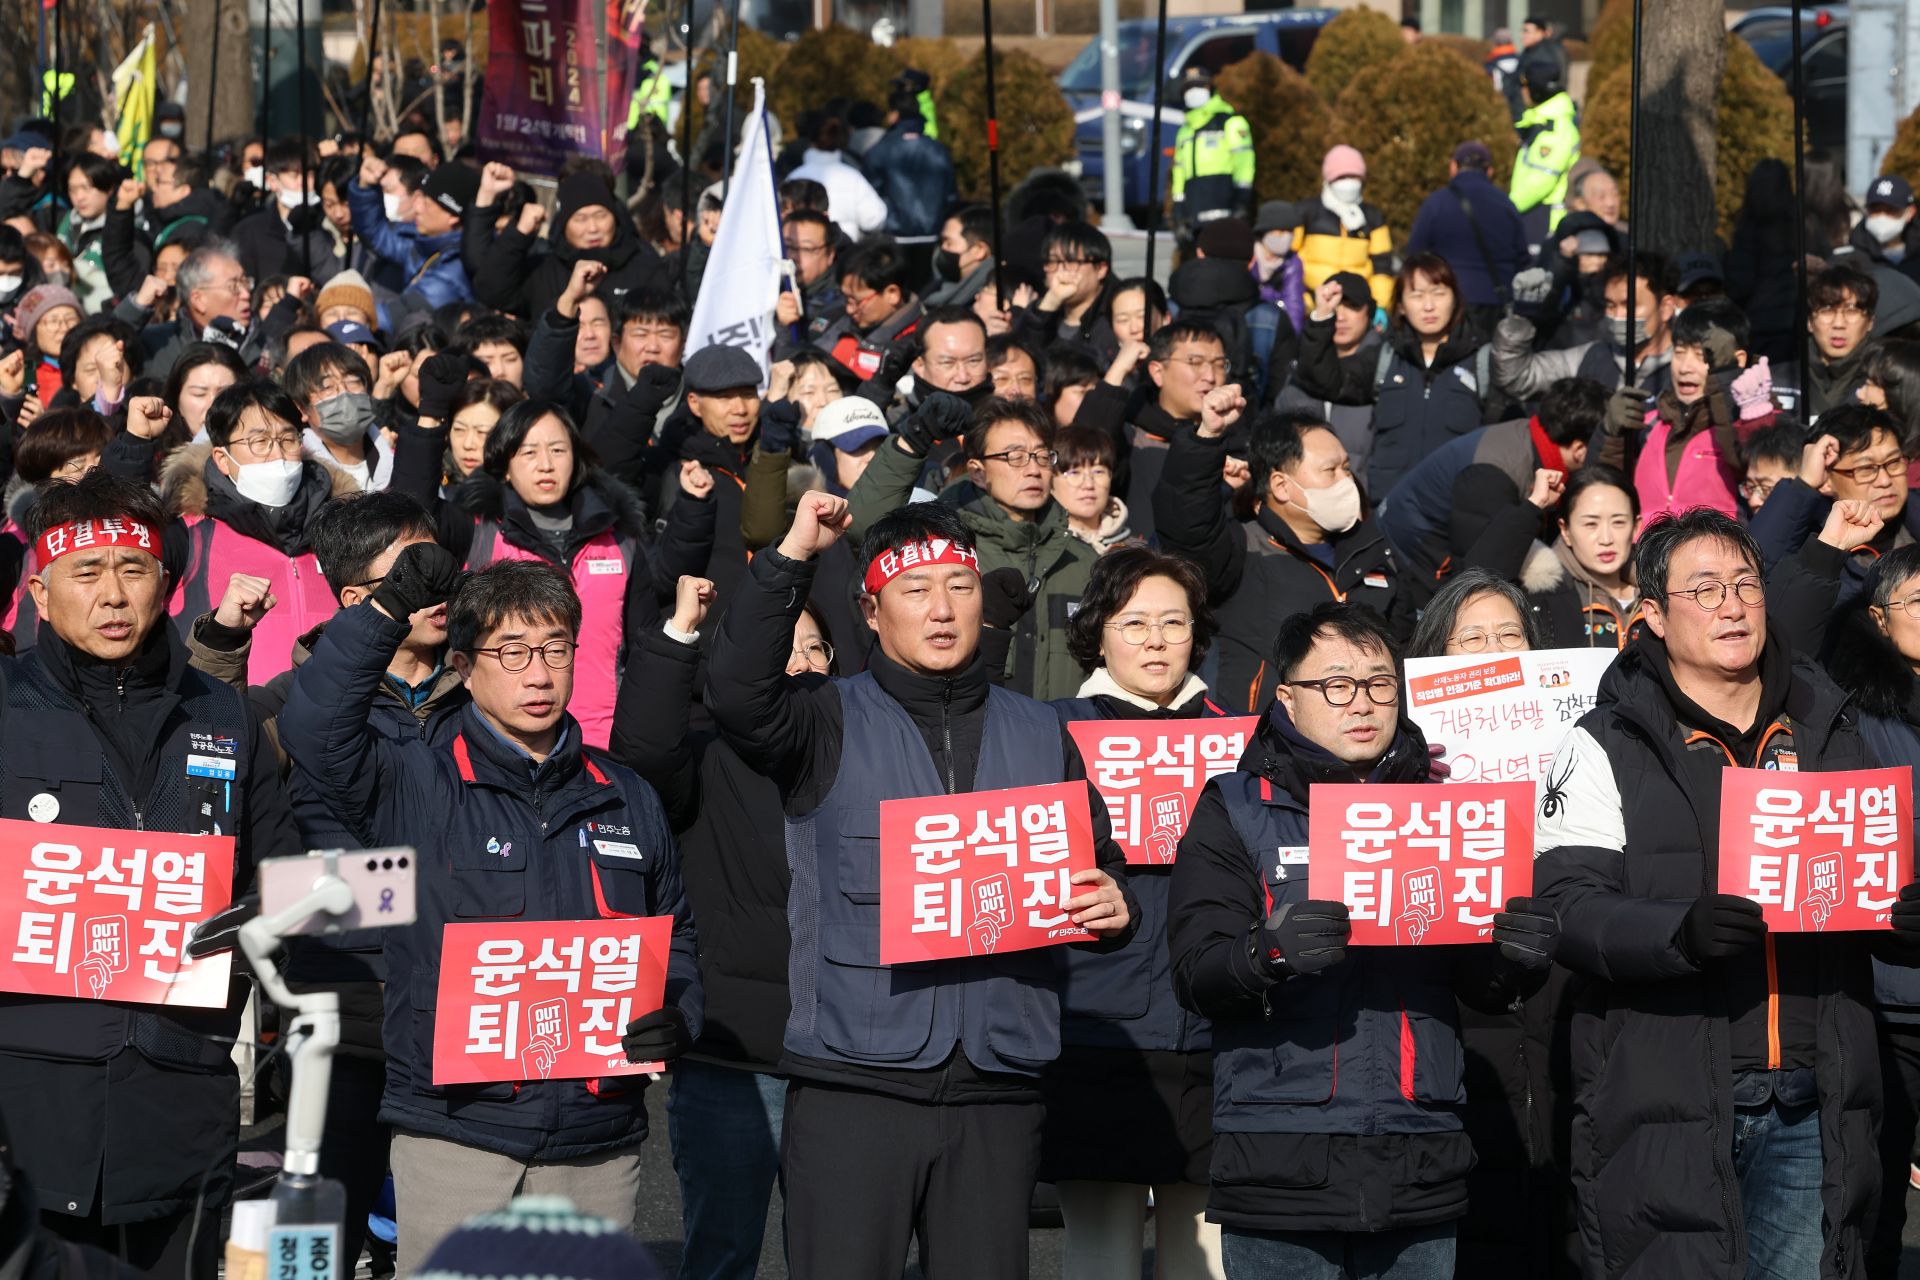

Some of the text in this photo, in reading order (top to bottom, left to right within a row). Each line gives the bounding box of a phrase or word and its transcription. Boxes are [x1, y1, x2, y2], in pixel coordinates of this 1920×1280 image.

[566, 29, 581, 104] 2024
[1416, 671, 1520, 700] 직업별 인정기준 확대하라!
[1434, 666, 1496, 686] 산재노동자 권리 보장
[1094, 732, 1244, 789] 윤석열
[1156, 799, 1179, 814] OUT
[1750, 784, 1898, 849] 윤석열
[598, 823, 631, 836] 민주노총
[910, 800, 1070, 875] 윤석열
[1340, 799, 1506, 863] 윤석열
[23, 842, 206, 915] 윤석열
[1813, 859, 1837, 876] OUT
[978, 881, 1002, 898] OUT
[1408, 874, 1434, 891] OUT
[92, 922, 120, 938] OUT
[470, 934, 641, 997] 윤석열
[535, 1004, 561, 1022] OUT
